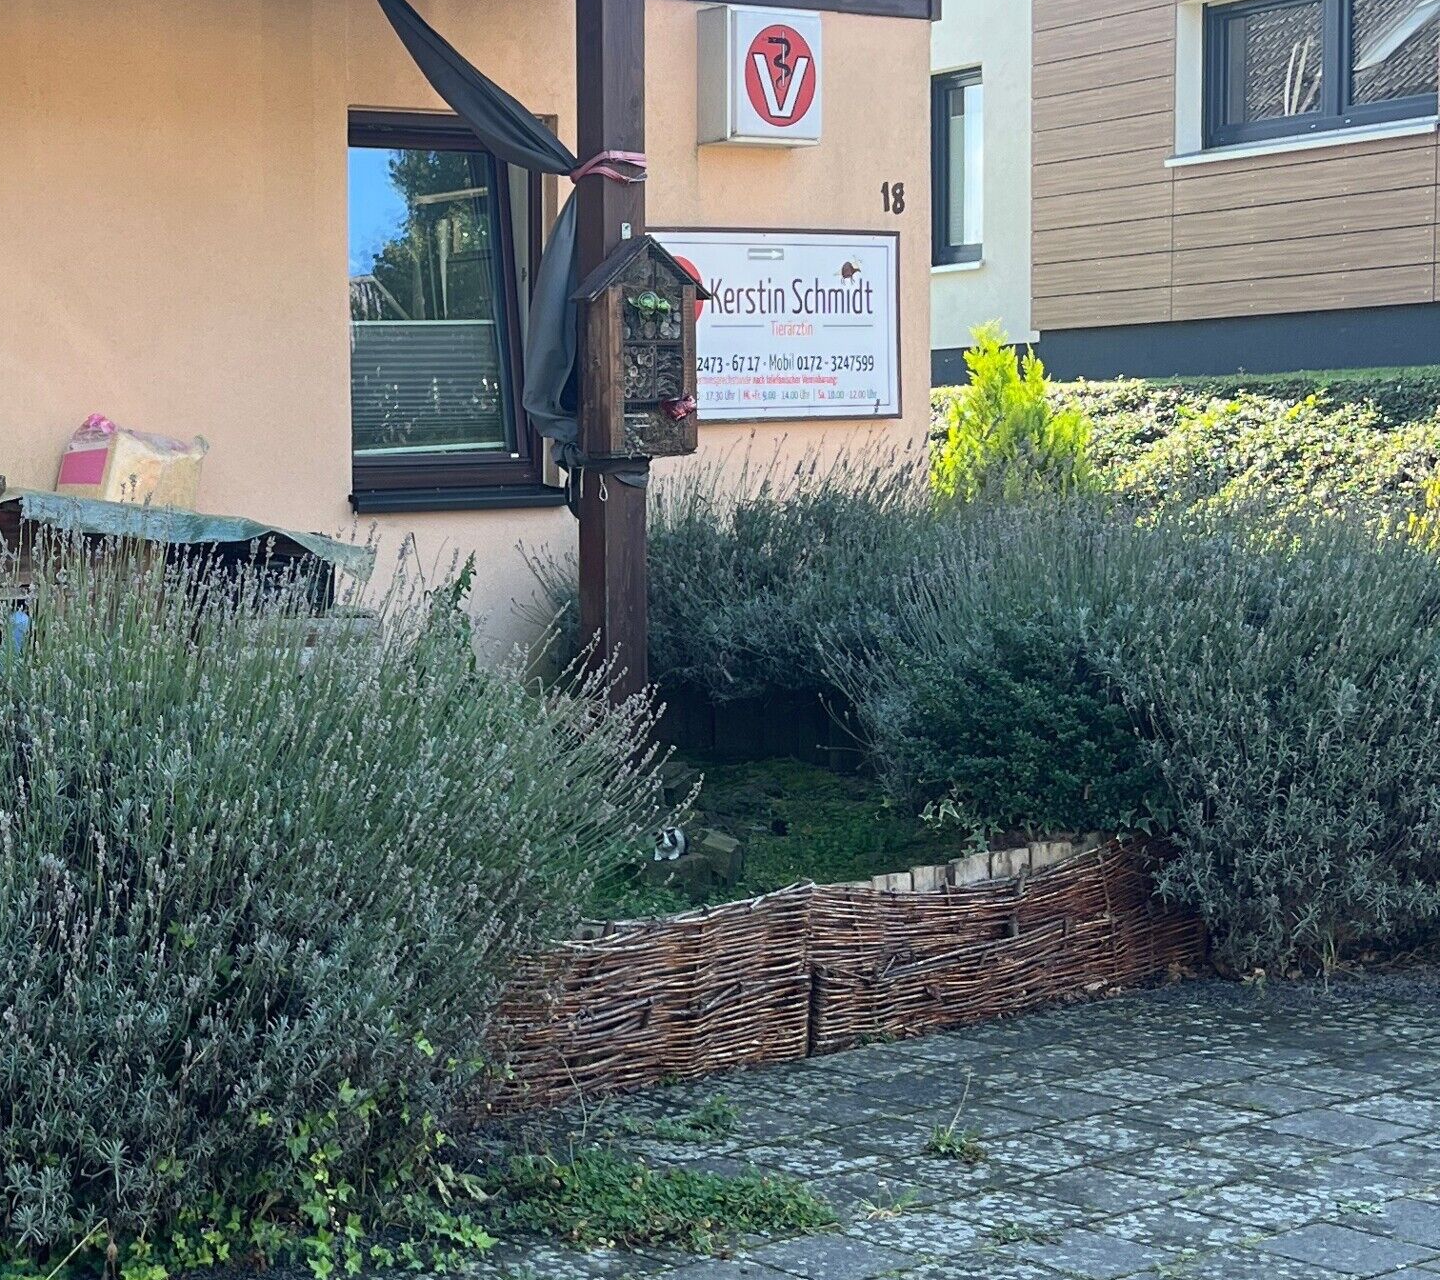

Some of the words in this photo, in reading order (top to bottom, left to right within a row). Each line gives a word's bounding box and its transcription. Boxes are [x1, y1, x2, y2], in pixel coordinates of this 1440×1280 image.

[880, 181, 905, 214] 18
[710, 277, 785, 314] Kerstin
[791, 277, 874, 314] Schmidt
[770, 320, 814, 336] Tierärztin
[769, 353, 795, 371] Mobil
[797, 355, 822, 371] 0172
[831, 354, 874, 372] 3247599
